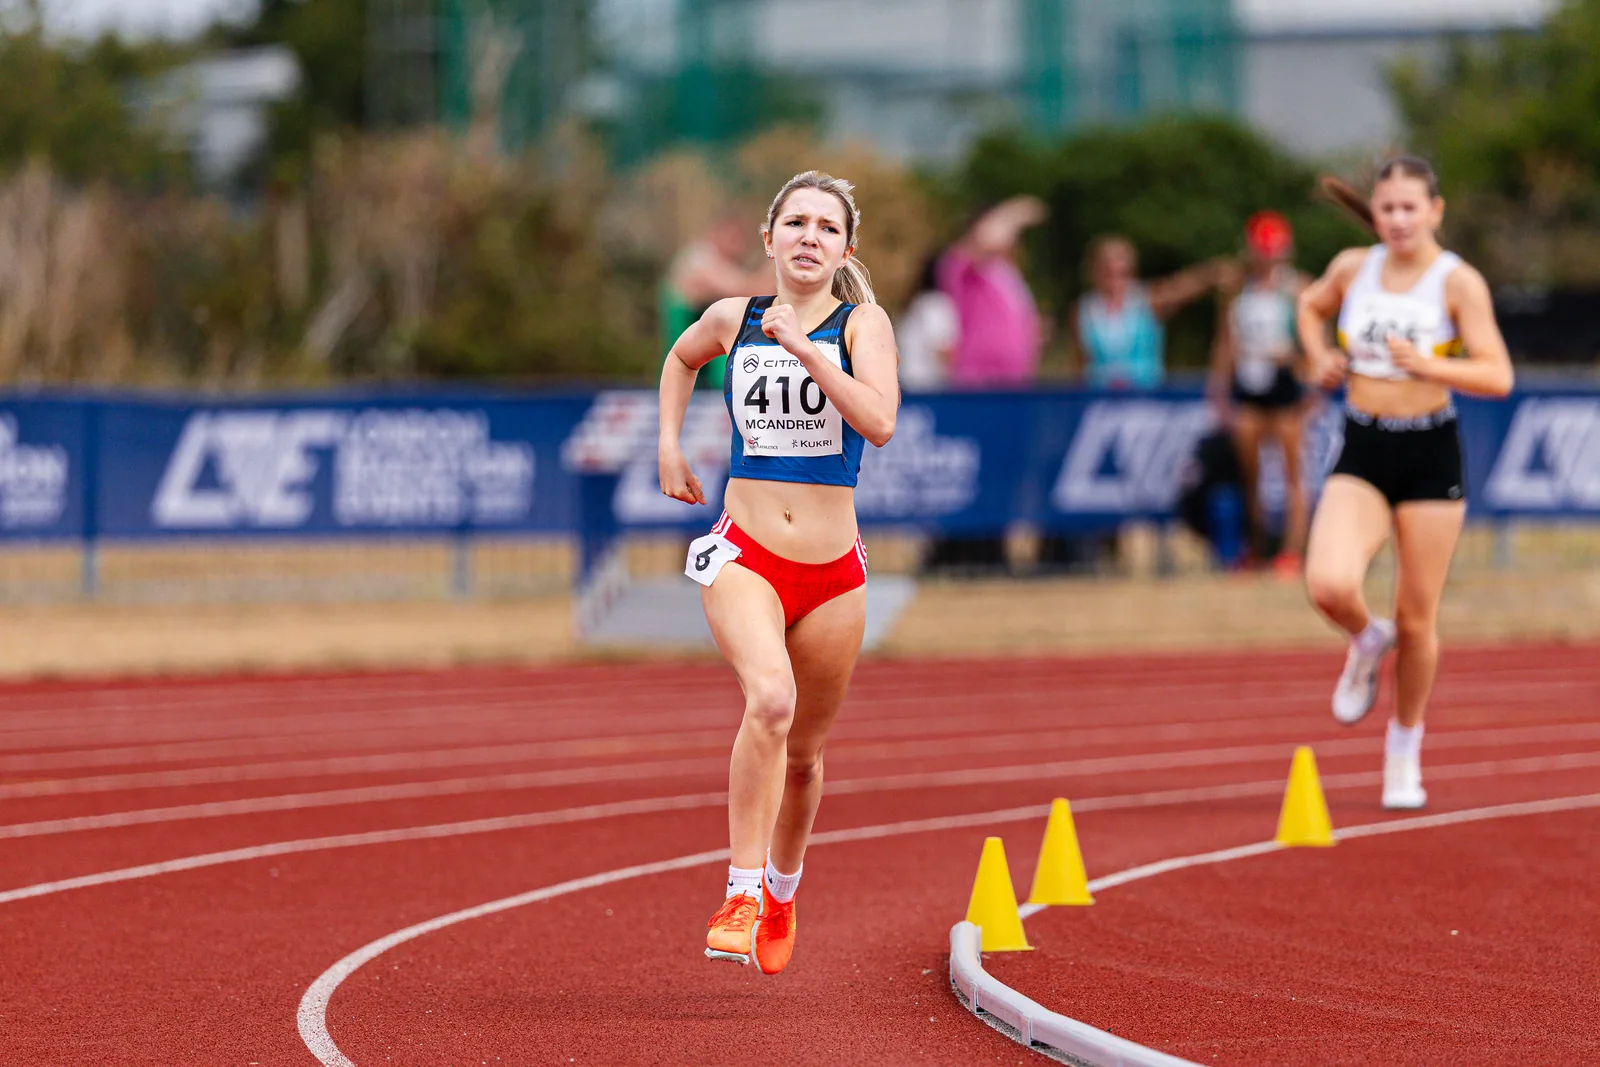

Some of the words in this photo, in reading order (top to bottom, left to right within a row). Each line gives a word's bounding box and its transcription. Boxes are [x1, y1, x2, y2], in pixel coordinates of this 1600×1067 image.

[744, 375, 827, 415] 410
[745, 418, 826, 430] MCANDREW
[800, 439, 833, 448] KUKRI
[694, 543, 718, 572] 6
